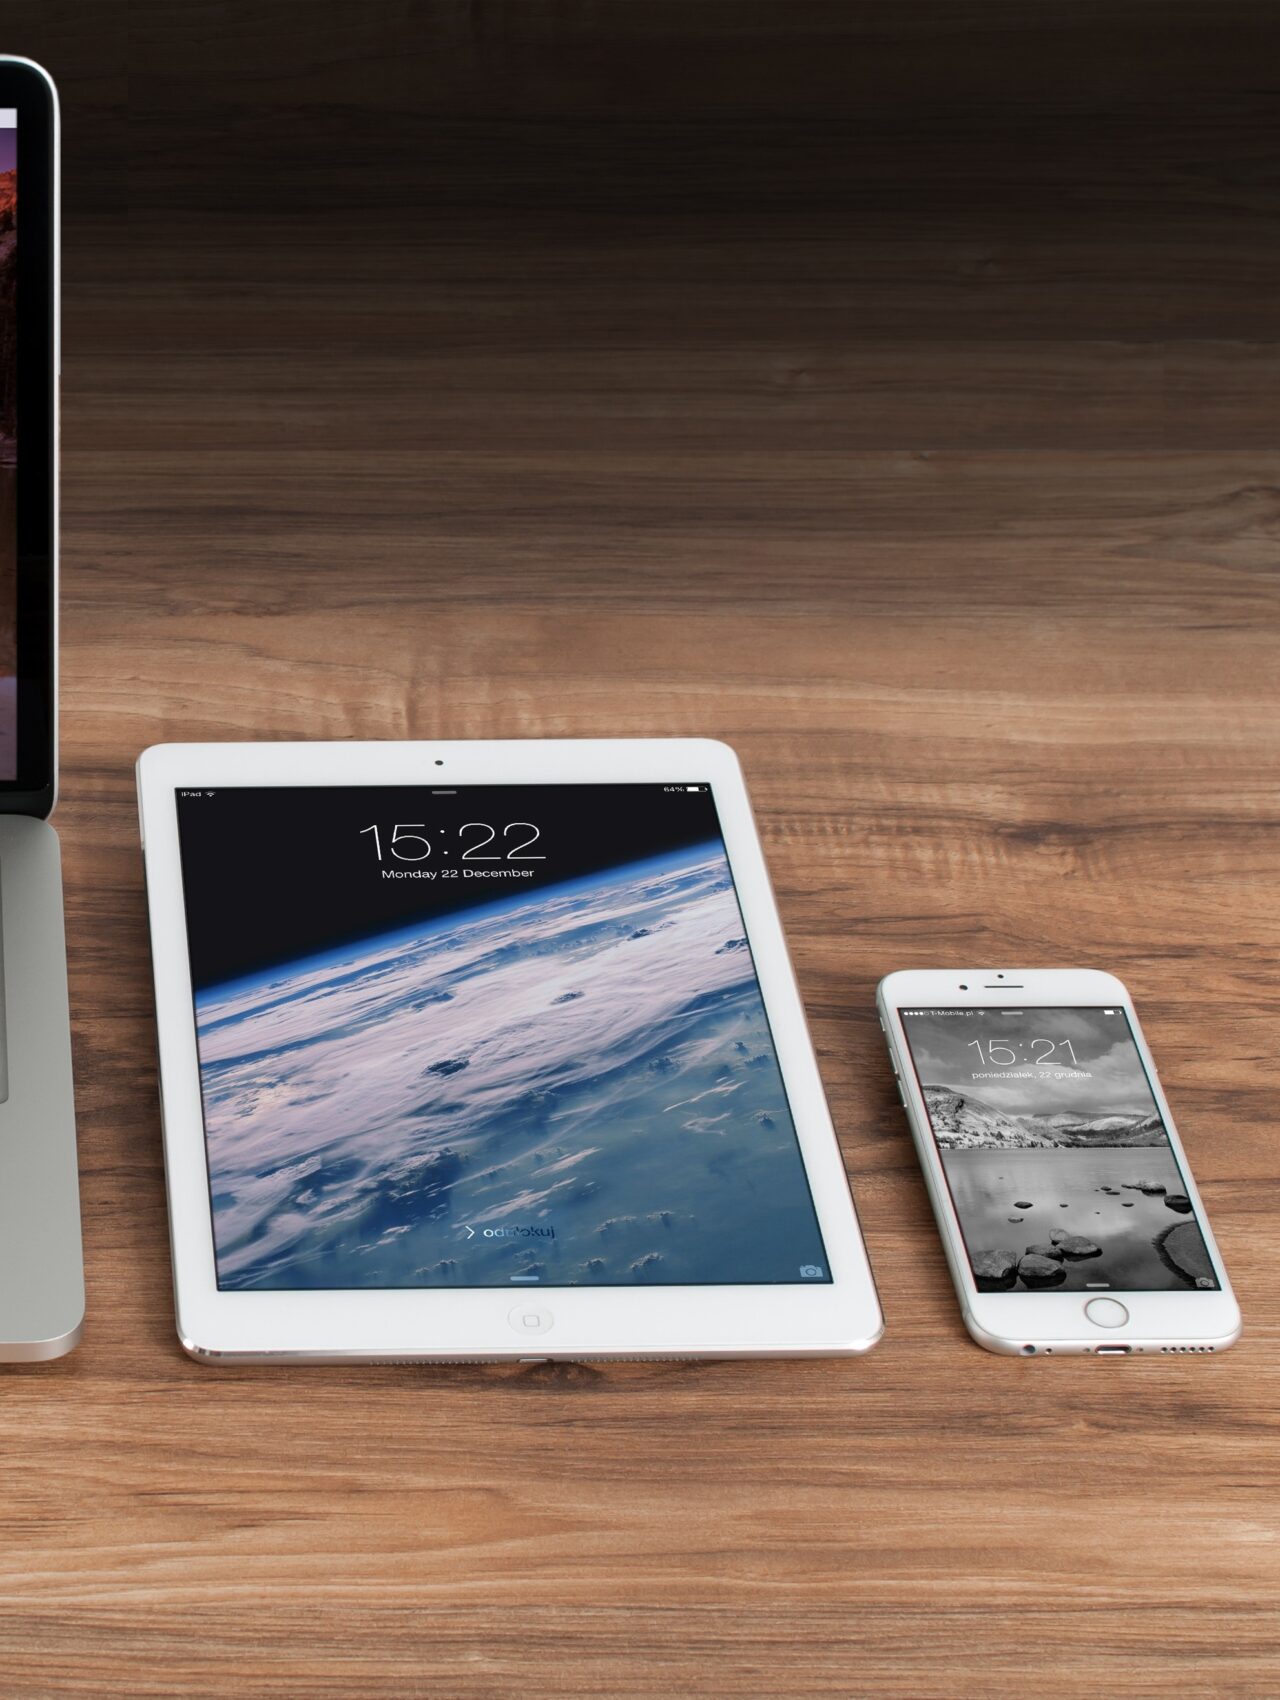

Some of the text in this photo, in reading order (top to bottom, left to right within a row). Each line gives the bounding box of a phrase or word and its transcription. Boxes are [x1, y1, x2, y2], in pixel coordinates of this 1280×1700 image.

[359, 822, 547, 861] 15:22
[381, 868, 535, 881] Monday 22 December
[967, 1039, 1078, 1065] 15:21
[1054, 1071, 1092, 1080] grudnia
